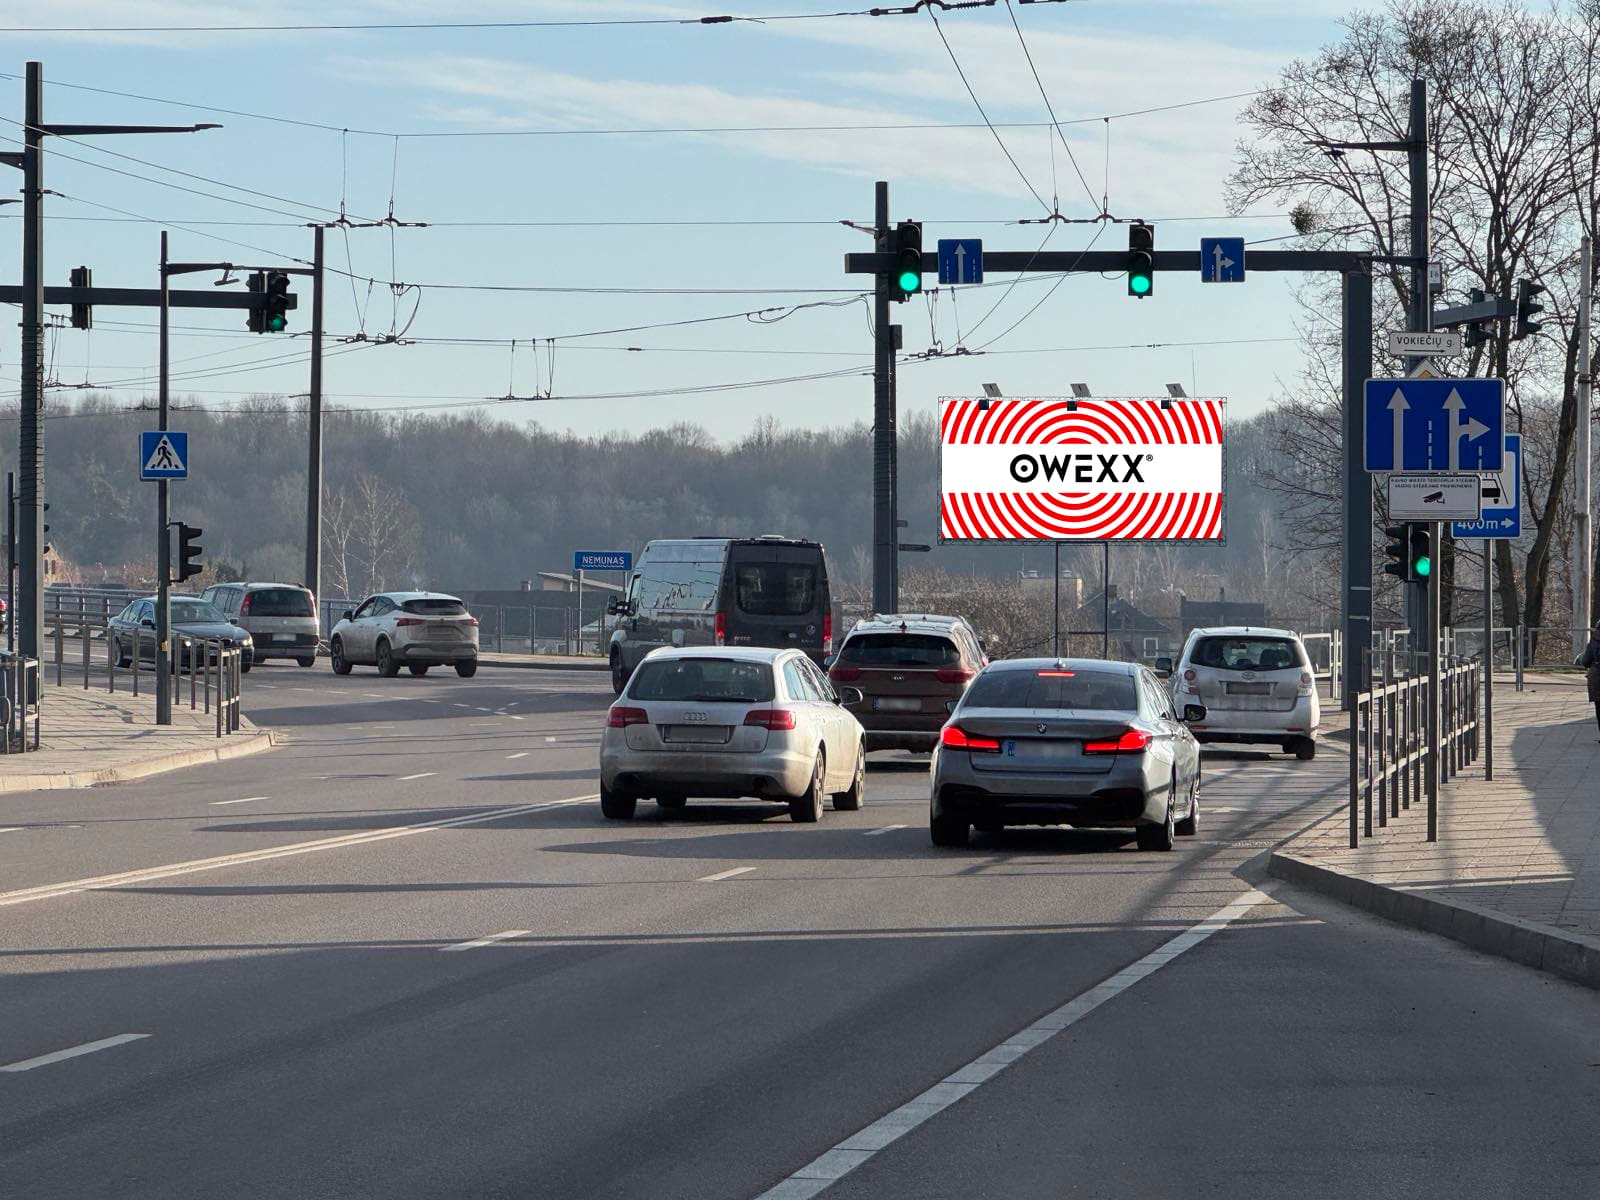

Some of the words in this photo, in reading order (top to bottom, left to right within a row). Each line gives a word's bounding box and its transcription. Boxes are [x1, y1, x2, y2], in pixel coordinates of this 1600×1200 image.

[1396, 335, 1442, 348] VOKIEČIŲ
[1446, 339, 1455, 348] g.
[582, 555, 625, 565] NEMUNAS
